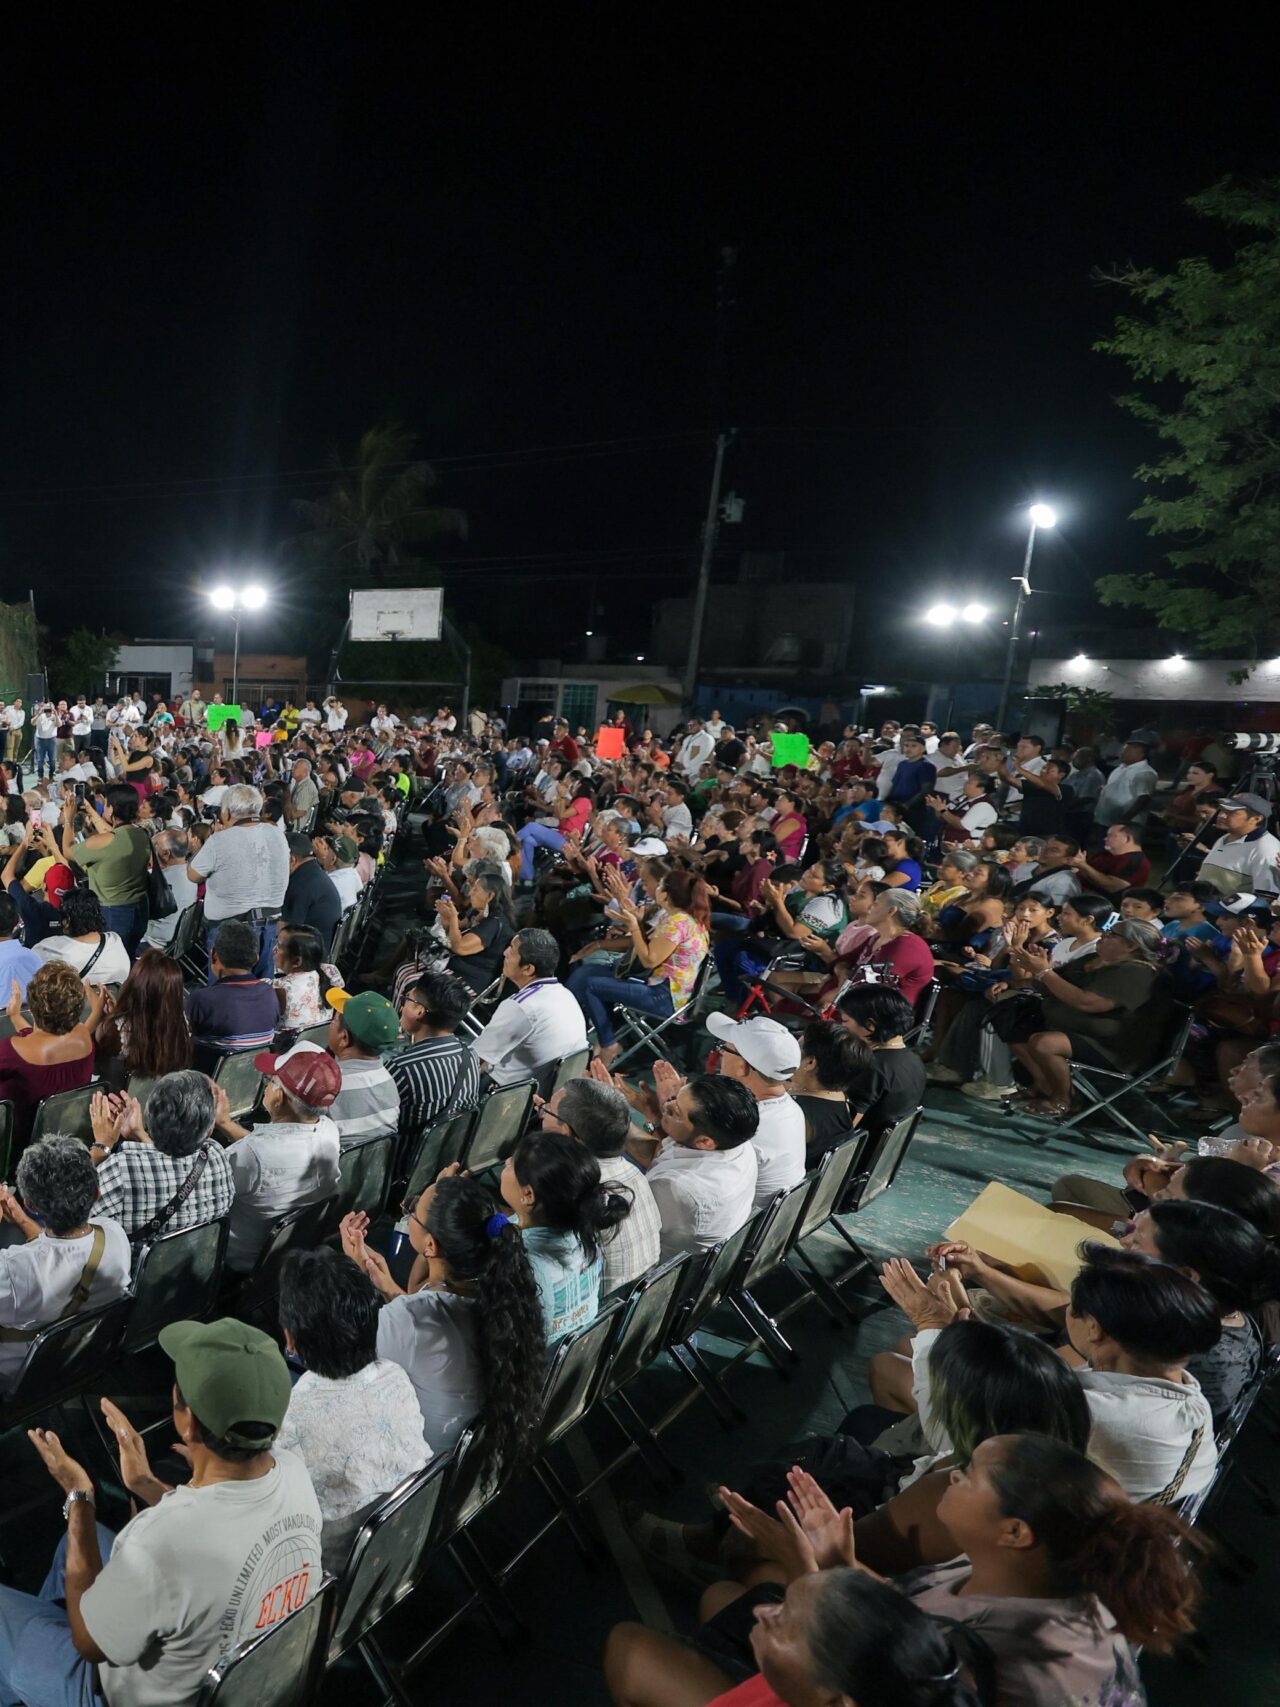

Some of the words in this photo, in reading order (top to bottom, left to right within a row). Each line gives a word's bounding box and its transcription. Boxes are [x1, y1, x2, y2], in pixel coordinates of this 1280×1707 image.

[262, 1520, 282, 1546] MOST
[228, 1542, 264, 1606] UNLIMITED
[220, 1608, 238, 1632] ECKO
